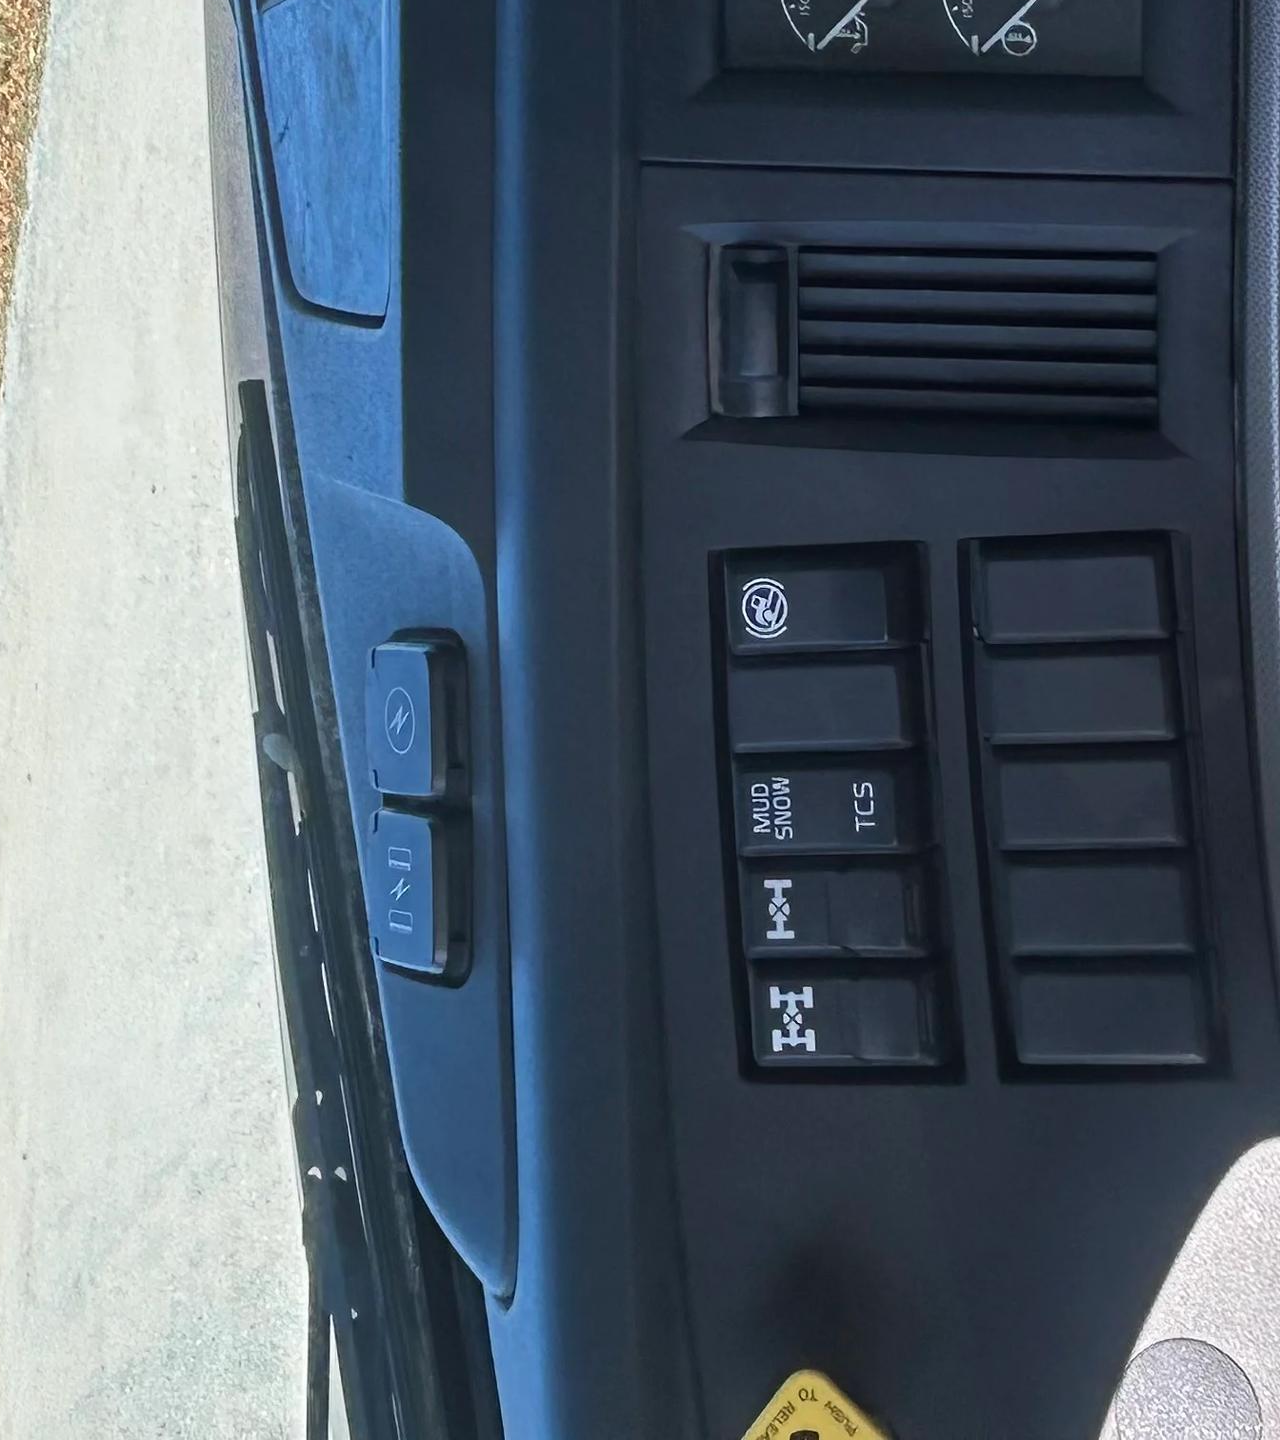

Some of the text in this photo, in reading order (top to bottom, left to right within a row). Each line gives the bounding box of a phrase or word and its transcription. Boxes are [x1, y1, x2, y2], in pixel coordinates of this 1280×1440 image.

[751, 783, 771, 833] MUD
[771, 777, 793, 840] SNOW
[852, 782, 876, 832] TCS
[798, 1388, 818, 1402] TO
